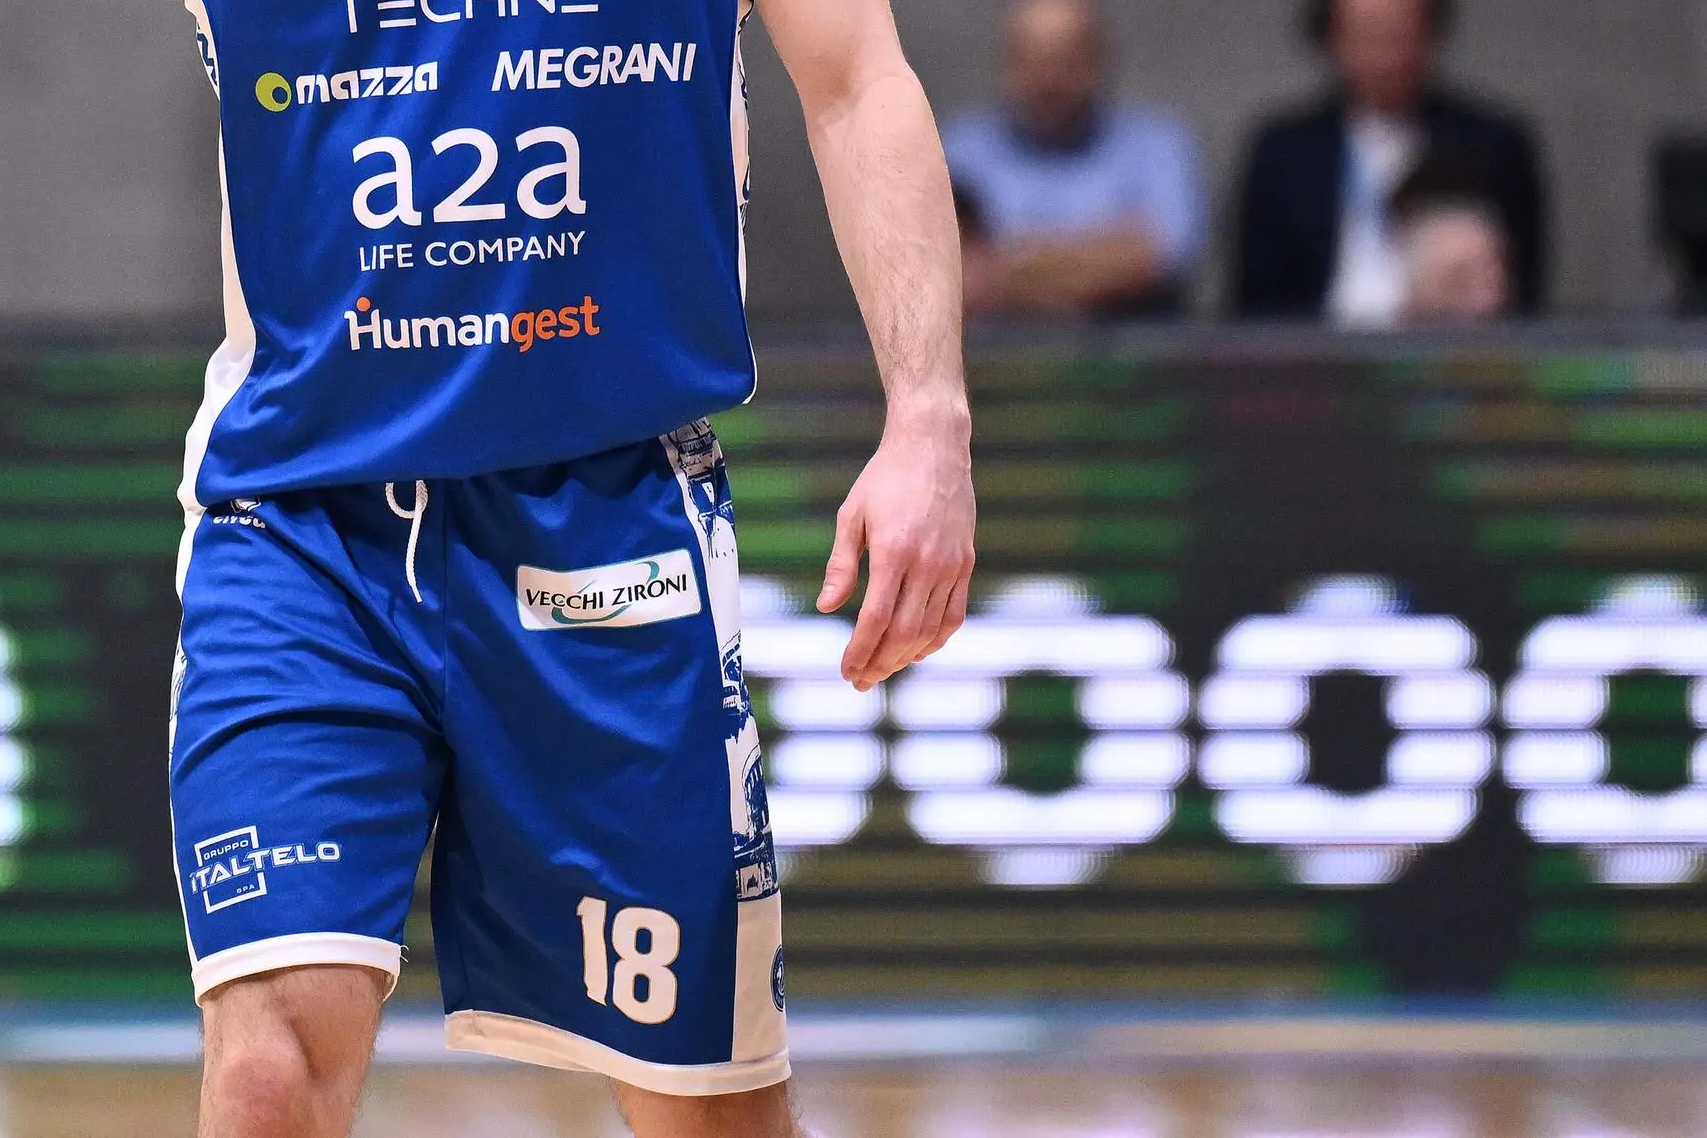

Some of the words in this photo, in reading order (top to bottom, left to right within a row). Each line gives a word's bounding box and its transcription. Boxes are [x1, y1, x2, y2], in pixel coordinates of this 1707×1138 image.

[295, 61, 438, 104] mazza
[491, 42, 697, 92] MEGRANI
[352, 125, 587, 230] a2a
[359, 243, 414, 272] LIFE
[425, 230, 586, 267] COMPANY
[344, 295, 601, 353] Humangest
[525, 588, 604, 610] VECCHI
[611, 573, 687, 606] ZIRONI
[203, 839, 250, 861] GRUPPO
[576, 895, 682, 1025] 18
